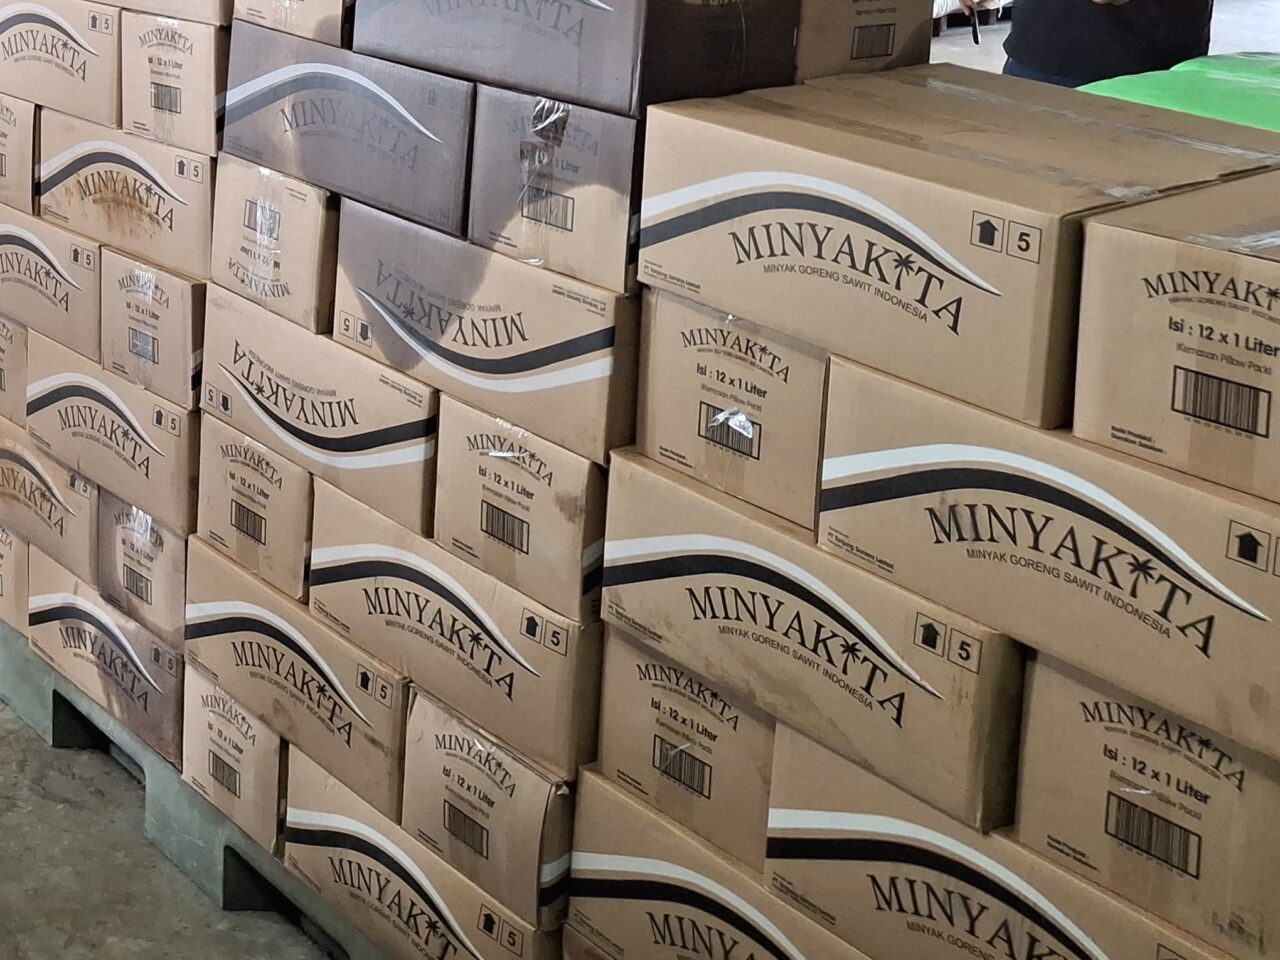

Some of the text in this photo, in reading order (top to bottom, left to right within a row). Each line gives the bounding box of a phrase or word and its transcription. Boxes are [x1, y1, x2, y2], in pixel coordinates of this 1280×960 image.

[1, 29, 87, 82] MINYAKITA
[138, 28, 194, 56] MINYAKITA
[193, 166, 199, 178] 5
[76, 170, 175, 232] MINYAKITA
[85, 255, 91, 266] 5
[1017, 233, 1031, 252] 5
[375, 258, 529, 348] MINYAKITA
[728, 222, 964, 336] MINYAKITA
[763, 263, 928, 323] MINYAK GORENG SAWIT INDONESIA
[343, 318, 350, 331] 5
[1168, 316, 1184, 332] Isi
[1198, 324, 1214, 340] 12
[1245, 338, 1280, 357] Liter
[680, 328, 790, 383] MINYAKITA
[208, 390, 214, 401] 5
[231, 339, 360, 428] MINYAKITA
[715, 369, 726, 383] 12
[744, 381, 768, 399] Liter
[57, 404, 150, 480] MINYAKITA
[170, 419, 177, 431] 5
[220, 444, 283, 490] MINYAKITA
[467, 433, 554, 488] MINYAKITA
[493, 471, 502, 485] 12
[516, 482, 535, 500] Liter
[925, 503, 1217, 659] MINYAKITA
[966, 548, 1172, 639] MINYAK GORENG SAWIT INDONESIA
[363, 587, 516, 702] MINYAKITA
[551, 630, 560, 647] 5
[686, 587, 906, 729] MINYAKITA
[958, 642, 972, 661] 5
[58, 626, 149, 713] MINYAKITA
[231, 641, 353, 748] MINYAKITA
[379, 684, 387, 699] 5
[718, 625, 874, 711] MINYAK GORENG SAWIT INDONESIA
[201, 694, 256, 747] MINYAKITA
[636, 664, 741, 732] MINYAKITA
[668, 706, 680, 721] 12
[696, 723, 718, 741] Liter
[435, 733, 516, 799] MINYAKITA
[1080, 701, 1246, 792] MINYAKITA
[1103, 744, 1118, 762] Isi
[1132, 756, 1147, 776] 12
[1176, 776, 1211, 805] Liter
[507, 934, 516, 946] 5
[906, 920, 945, 942] MINYAK
